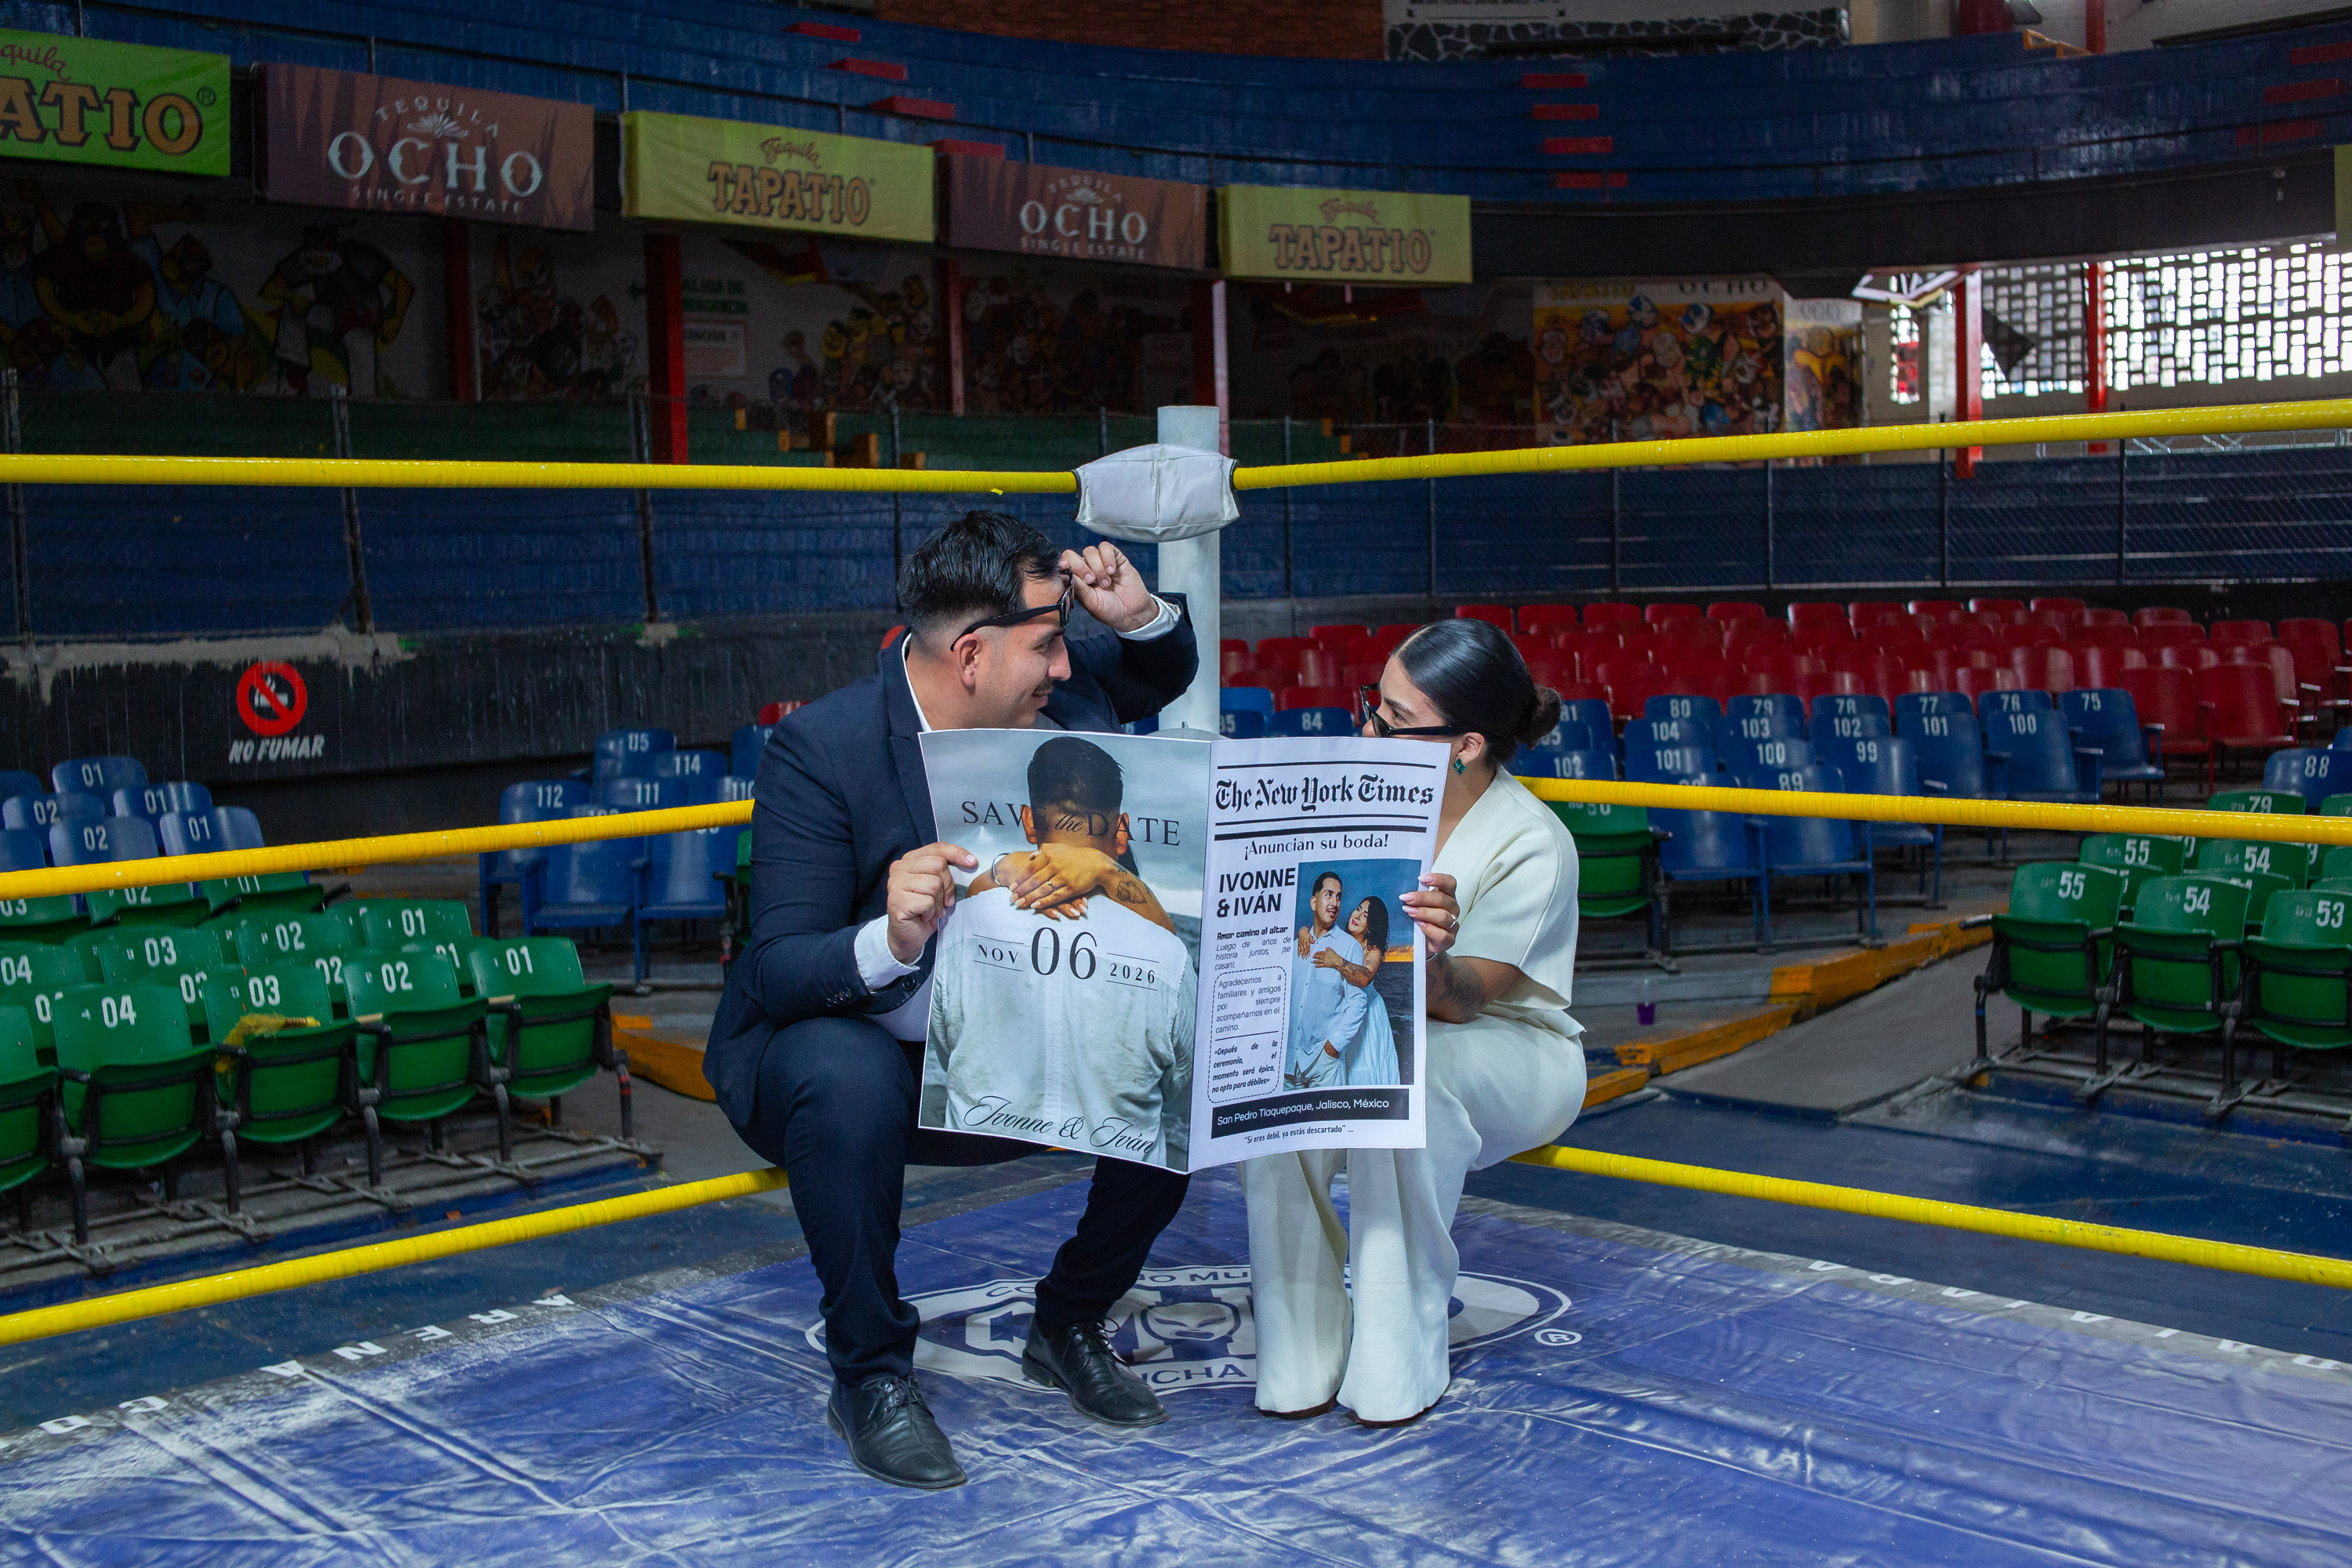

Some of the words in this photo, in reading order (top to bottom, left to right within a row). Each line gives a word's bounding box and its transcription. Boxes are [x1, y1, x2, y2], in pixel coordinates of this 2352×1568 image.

[376, 95, 499, 137] TEQUILA
[327, 131, 543, 198] OCHO
[444, 193, 521, 213] ESTATE
[707, 161, 870, 226] TAPATIO
[1047, 176, 1123, 204] TEQUILA
[1018, 200, 1148, 244] OCHO
[1269, 223, 1432, 274] TAPATIO
[1670, 699, 1691, 718] 80
[1919, 696, 1938, 714] 77
[2082, 692, 2101, 712] 75
[1301, 712, 1323, 731] 84
[1651, 721, 1679, 742] 104
[1741, 717, 1771, 739] 103
[1834, 717, 1862, 738] 102
[1922, 717, 1947, 736] 101
[2009, 713, 2037, 735] 100
[229, 739, 256, 764] NO
[257, 735, 325, 762] FUMAR
[1757, 742, 1786, 765] 100
[1857, 740, 1878, 763] 99
[82, 762, 104, 788] 01
[674, 754, 701, 775] 114
[1554, 756, 1584, 779] 102
[2304, 755, 2330, 779] 88
[144, 789, 168, 815] 01
[537, 785, 563, 808] 112
[635, 782, 659, 806] 111
[1215, 779, 1252, 813] The
[1255, 778, 1299, 810] New
[1301, 775, 1354, 812] York
[1358, 774, 1435, 805] Times
[33, 800, 60, 826] 02
[961, 800, 1050, 831] SAVE
[1054, 812, 1083, 833] the
[1086, 811, 1181, 847] DATE
[83, 826, 108, 851] 02
[188, 815, 211, 841] 01
[1244, 838, 1314, 861] ¡Anuncian
[1320, 837, 1337, 849] su
[1343, 834, 1389, 848] boda!
[2125, 839, 2150, 865] 55
[2244, 846, 2271, 874] 54
[1219, 867, 1296, 893] IVONNE
[2057, 870, 2086, 900] 55
[1217, 898, 1230, 918] &
[1234, 891, 1281, 916] IVÁN
[2183, 886, 2210, 916] 54
[2315, 899, 2345, 928] 53
[401, 908, 426, 937] 01
[1217, 932, 1234, 941] Amor
[1236, 929, 1259, 938] camino
[275, 920, 305, 952] 02
[1216, 944, 1236, 953] Luego
[144, 936, 176, 967] 03
[506, 946, 533, 975] 01
[978, 944, 1018, 964] NOV
[1031, 927, 1097, 980] 06
[1110, 963, 1155, 984] 2026
[1215, 952, 1238, 961] historia
[1249, 948, 1269, 958] juntos,
[1, 955, 32, 985] 04
[381, 961, 413, 993] 02
[1218, 976, 1262, 989] Agradecemos
[249, 975, 281, 1007] 03
[1217, 1003, 1228, 1012] por
[1255, 996, 1280, 1008] siempre
[1218, 989, 1247, 1000] familiares
[1258, 985, 1281, 996] amigos
[35, 991, 64, 1023] 0
[102, 995, 136, 1028] 04
[1216, 1009, 1263, 1022] acompañarnos
[1215, 1024, 1240, 1034] camino.
[1212, 1069, 1239, 1080] momento
[1243, 1067, 1255, 1076] será
[1258, 1065, 1275, 1074] épico,
[1220, 1083, 1232, 1091] apto
[1233, 1082, 1246, 1091] para
[964, 1095, 1054, 1134] Ivonne
[1058, 1116, 1085, 1139] &
[1089, 1117, 1155, 1154] Iván
[1217, 1116, 1232, 1126] San
[1234, 1111, 1258, 1122] Pedro
[1259, 1103, 1314, 1118] Tlaquepaque,
[1316, 1099, 1351, 1110] Jalisco,
[1353, 1098, 1389, 1109] México
[1254, 1134, 1265, 1142] eres
[1290, 1126, 1305, 1136] estás
